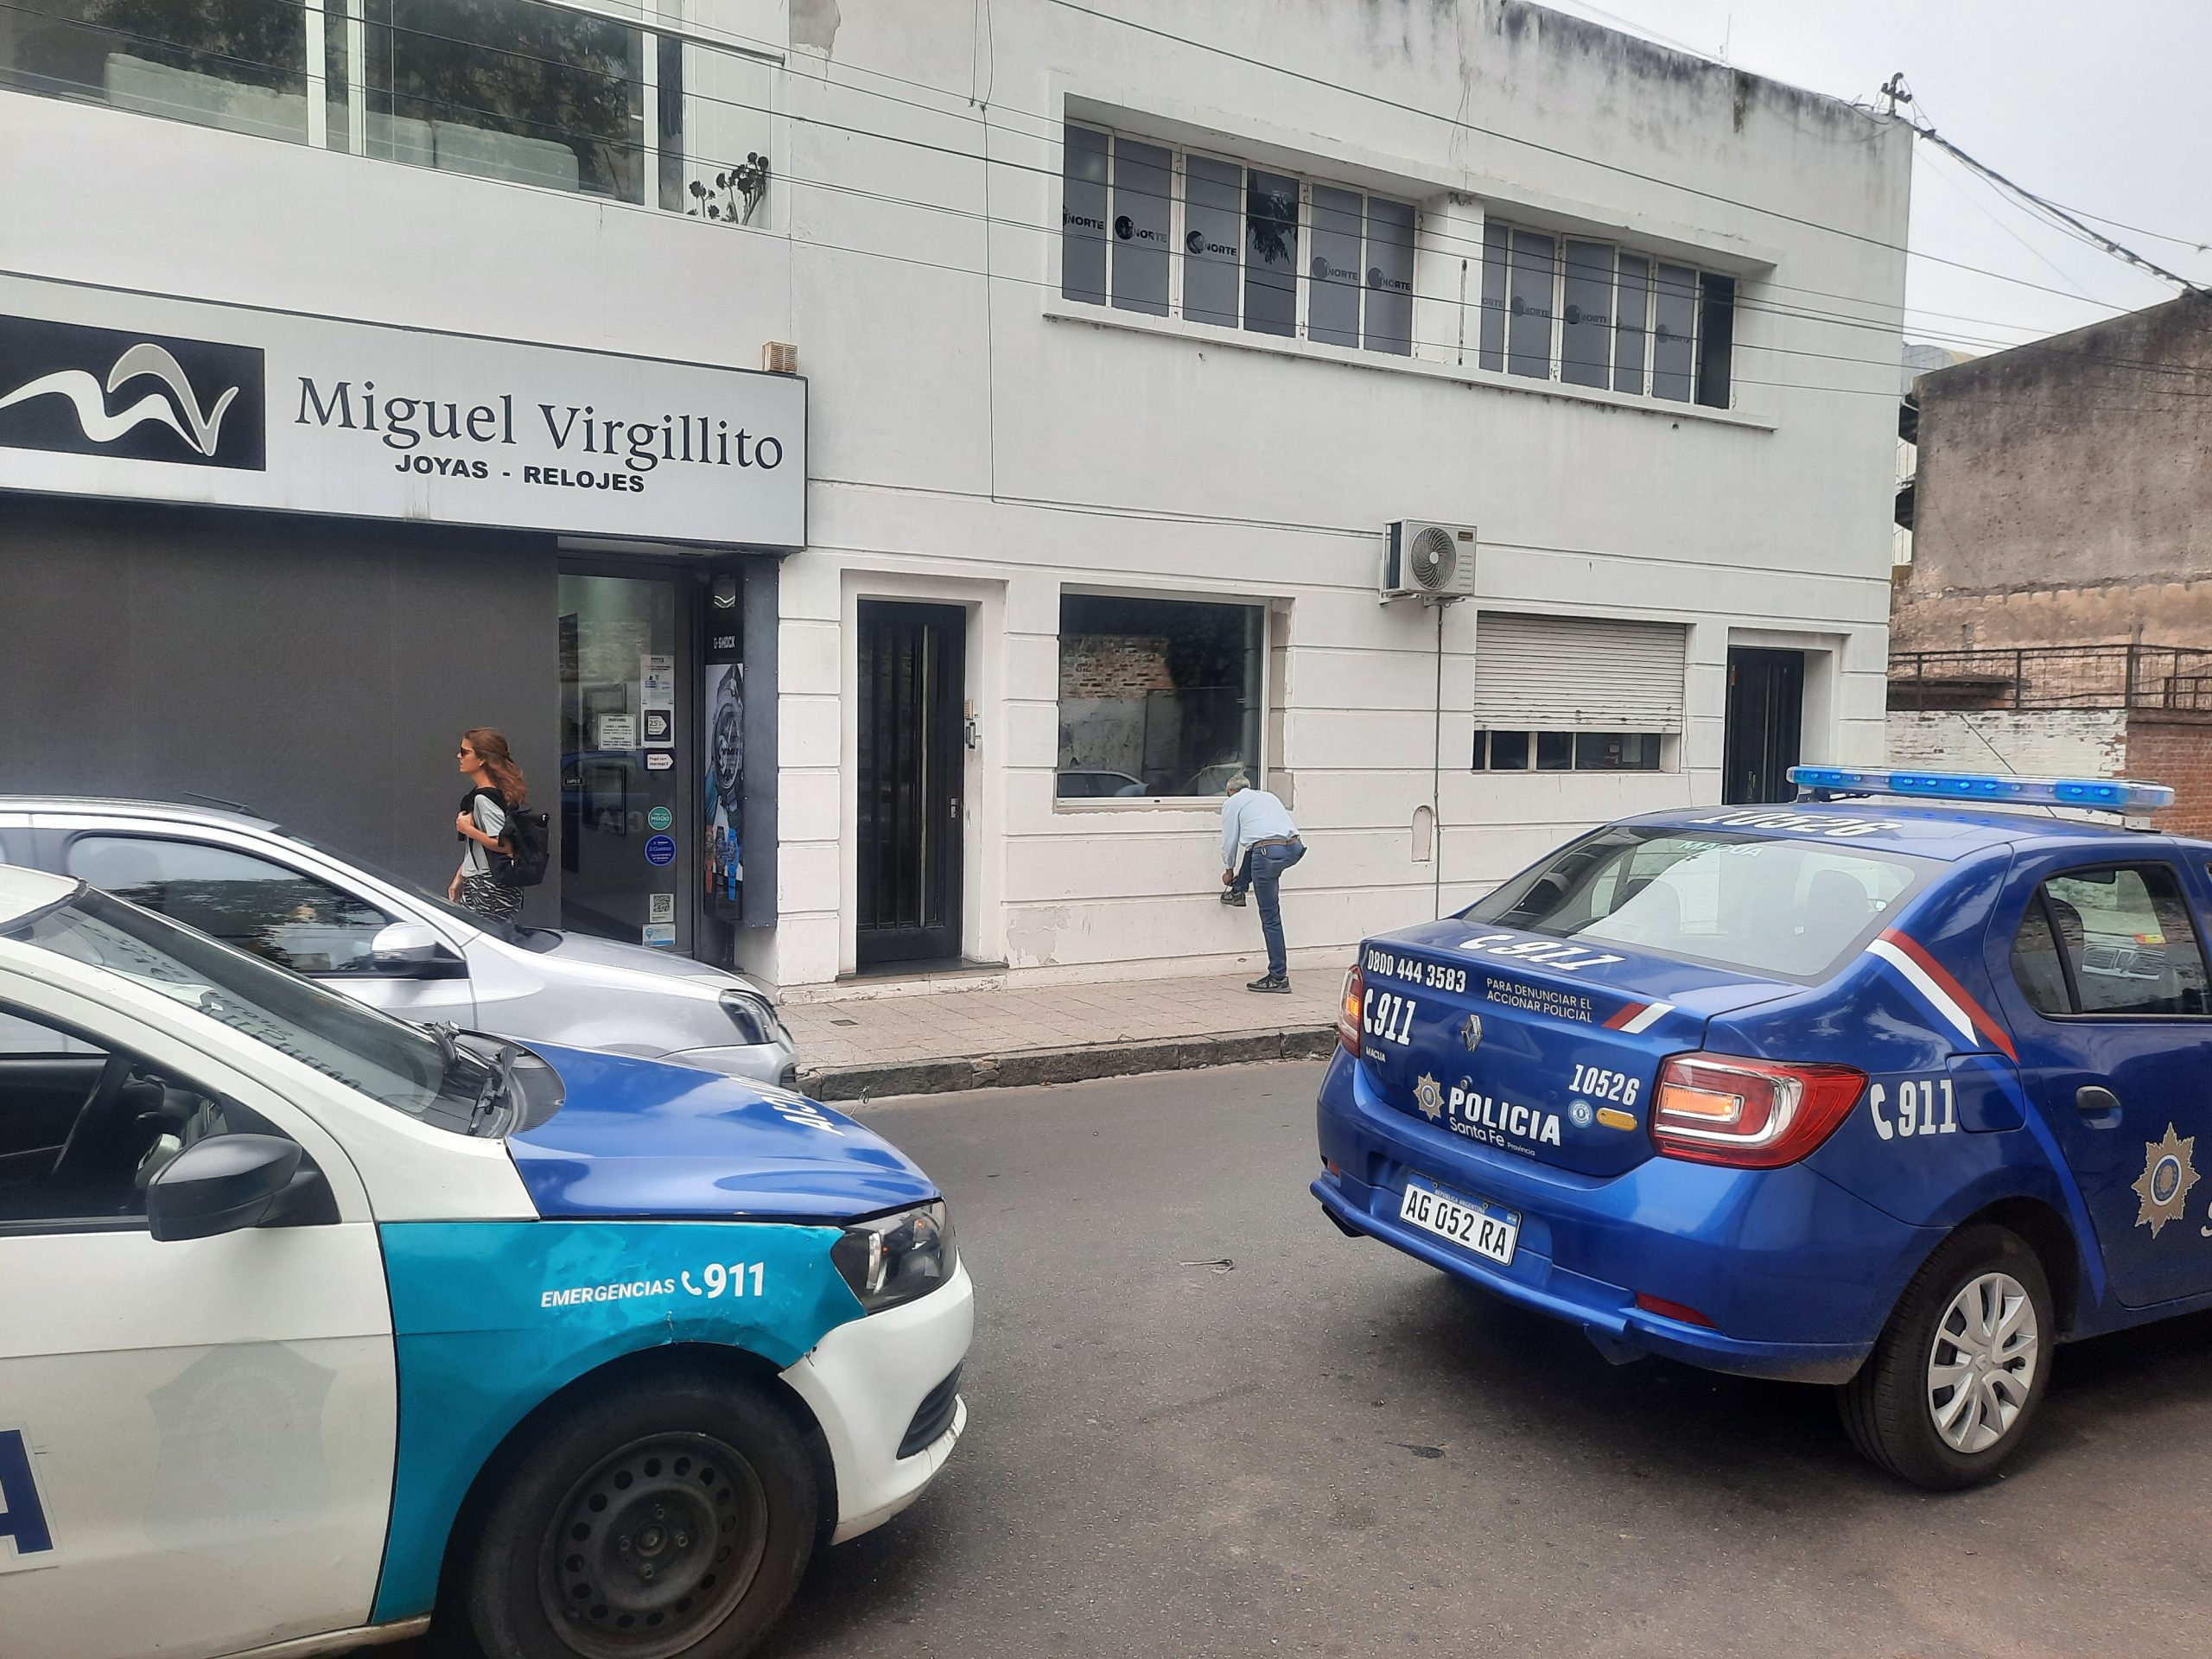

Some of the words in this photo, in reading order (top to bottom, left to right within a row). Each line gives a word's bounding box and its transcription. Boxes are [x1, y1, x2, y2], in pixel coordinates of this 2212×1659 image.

[1066, 215, 1105, 231] NORTE
[1134, 227, 1168, 243] NORTE
[1205, 243, 1237, 257] NORTE
[1328, 268, 1357, 281] NORTE
[1382, 278, 1411, 290] NORTE
[294, 375, 518, 449] Miguel
[537, 403, 784, 472] Virgillito
[395, 453, 489, 480] JOYAS
[524, 465, 645, 493] RELOJES
[1687, 810, 1904, 836] 10526
[1677, 841, 1764, 857] MACUA
[1367, 950, 1393, 976] 0800
[1396, 959, 1422, 984] 444
[1426, 966, 1466, 993] 3583
[1486, 940, 1627, 971] 911
[1486, 977, 1512, 993] PARA
[1515, 984, 1577, 1007] DENUNCIAR
[1580, 997, 1592, 1010] EL
[1486, 990, 1541, 1012] ACCIONAR
[1543, 1003, 1592, 1023] POLICIAL
[1374, 992, 1417, 1047] 911
[1365, 1046, 1386, 1063] MACUA
[1568, 1063, 1639, 1106] 10526
[1448, 1086, 1560, 1147] POLICIA
[1897, 1078, 1957, 1137] 911
[1449, 1116, 1486, 1141] Santa
[1489, 1128, 1505, 1147] Fe
[1507, 1141, 1536, 1156] Provincia
[1405, 1190, 1432, 1223] AG
[1434, 1202, 1475, 1242] 052
[1478, 1219, 1508, 1256] RA
[540, 1277, 676, 1308] EMERGENCIAS
[702, 1261, 765, 1299] 911
